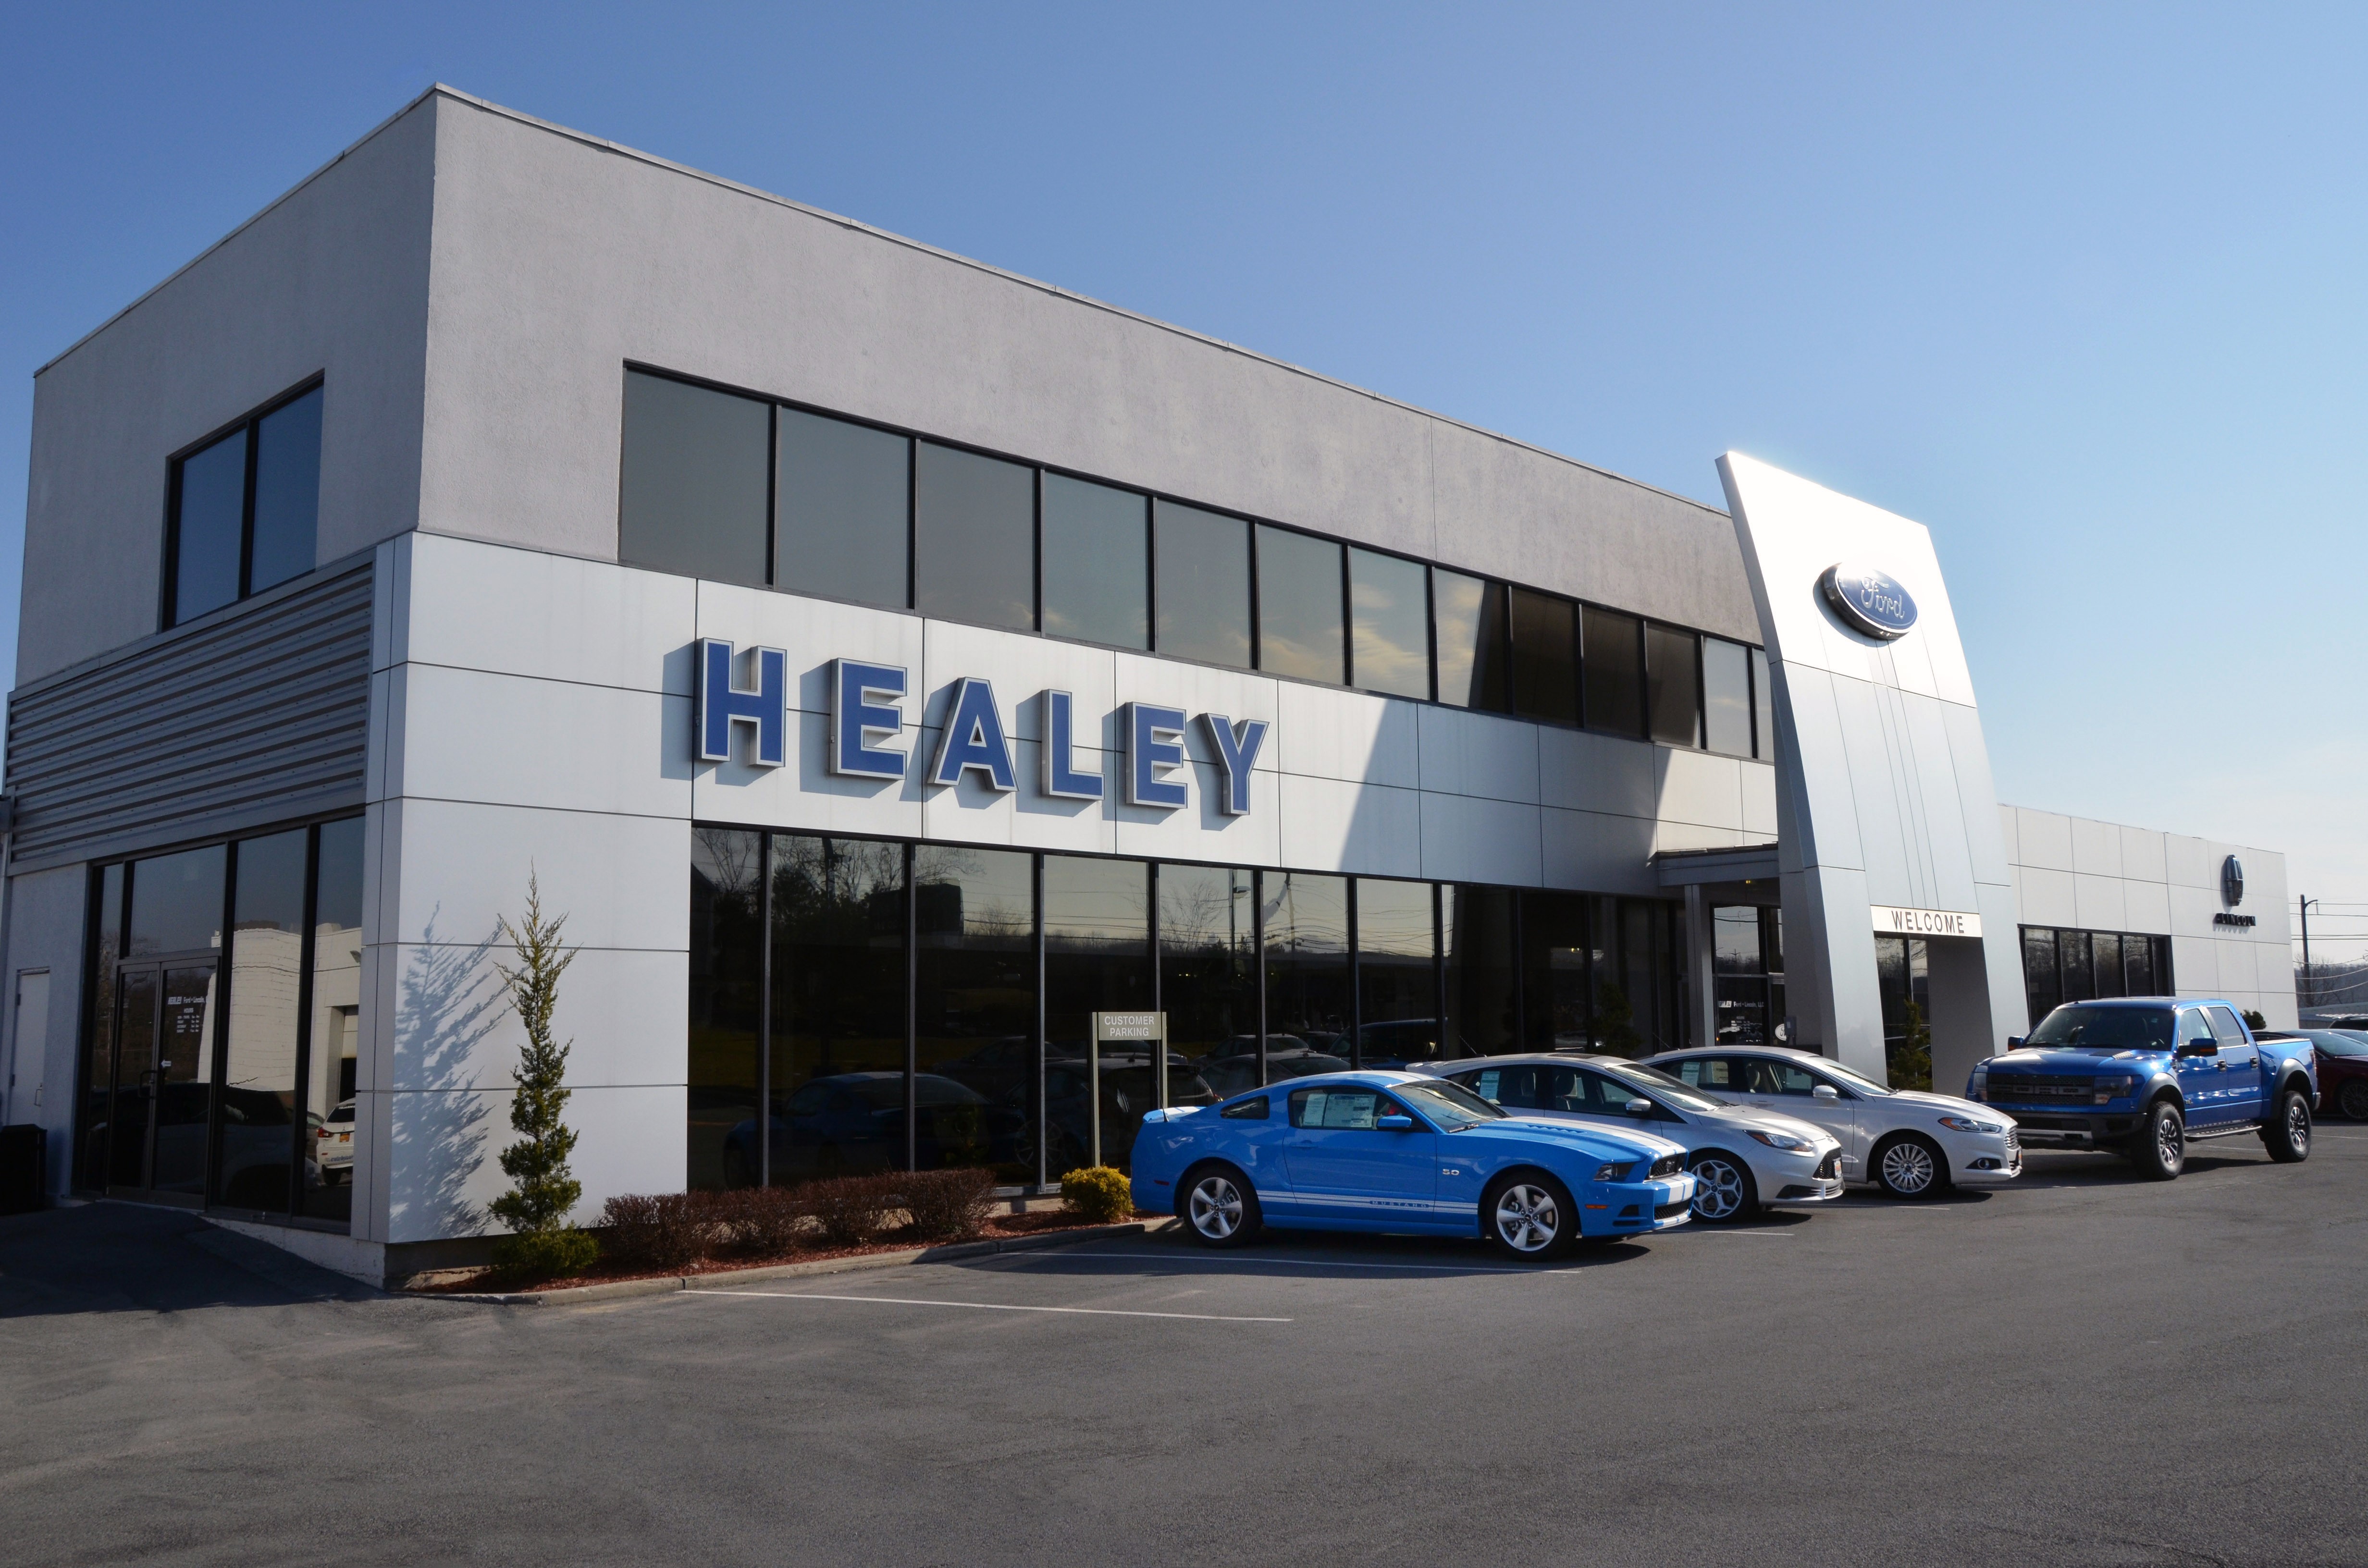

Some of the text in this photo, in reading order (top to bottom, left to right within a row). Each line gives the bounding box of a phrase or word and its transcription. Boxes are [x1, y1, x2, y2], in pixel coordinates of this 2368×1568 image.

[1861, 576, 1905, 619] Ford
[695, 637, 1270, 816] HEALEY
[1891, 910, 1964, 933] WELCOME
[2218, 913, 2256, 927] LINCOLN
[1104, 1016, 1154, 1025] CUSTOMER
[1110, 1028, 1149, 1037] PARKING
